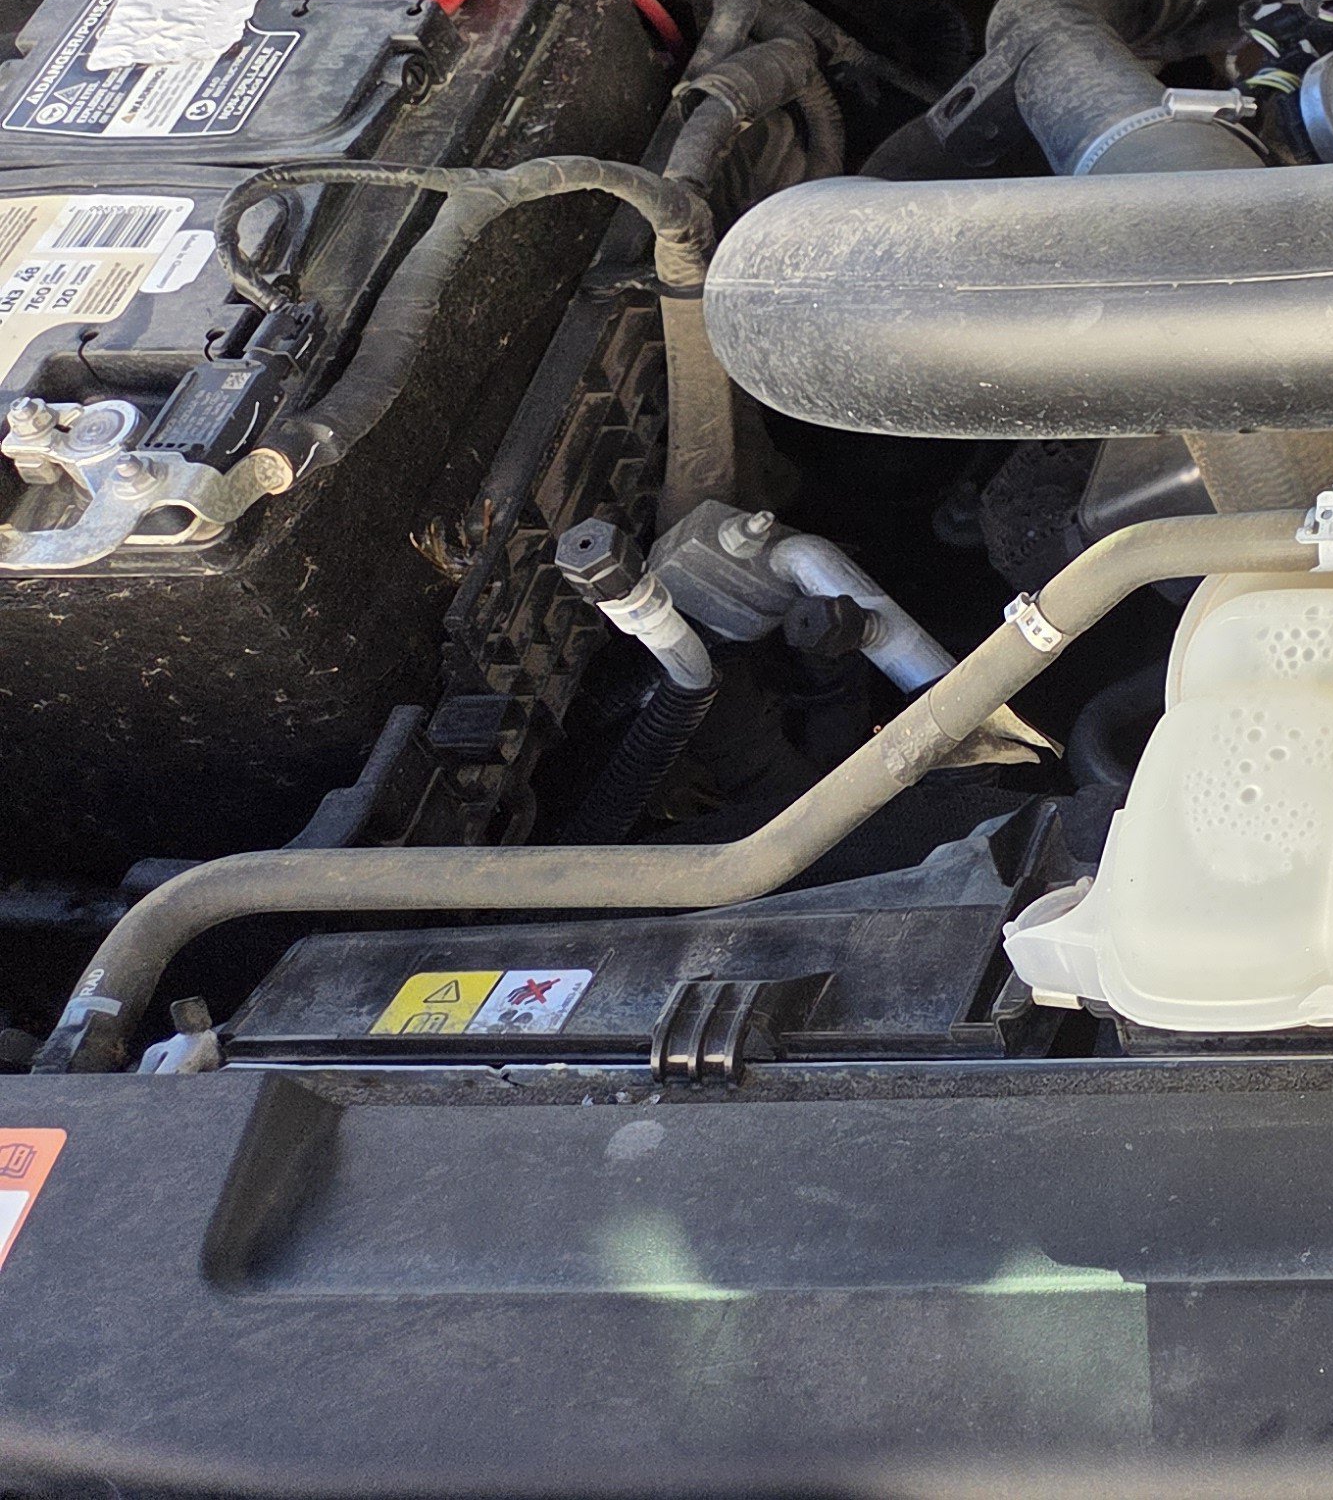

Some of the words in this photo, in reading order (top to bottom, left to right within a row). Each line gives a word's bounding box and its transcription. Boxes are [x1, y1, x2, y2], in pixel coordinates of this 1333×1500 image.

[24, 287, 52, 312] 760
[52, 288, 79, 310] 120
[79, 968, 105, 996] RAD
